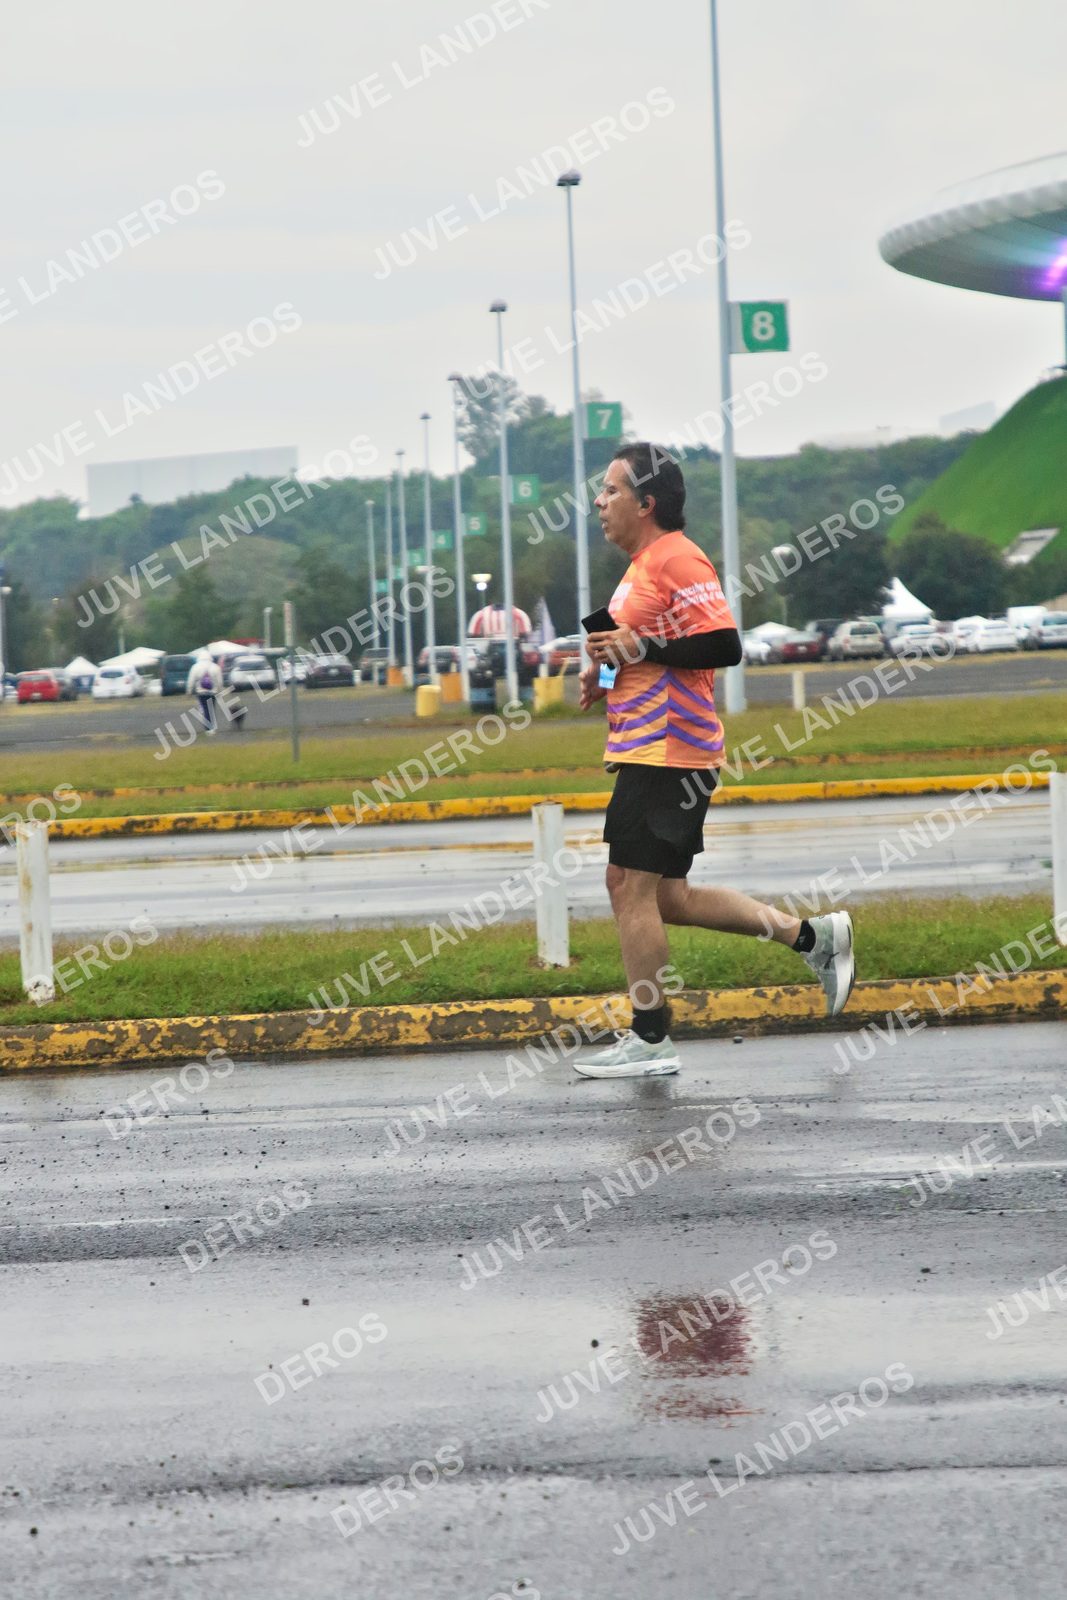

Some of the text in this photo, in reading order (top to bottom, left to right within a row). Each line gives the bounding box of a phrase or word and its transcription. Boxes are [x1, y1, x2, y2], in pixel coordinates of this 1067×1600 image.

[752, 311, 776, 341] 8
[596, 409, 613, 430] 7
[518, 481, 532, 497] 6
[470, 517, 481, 530] 5
